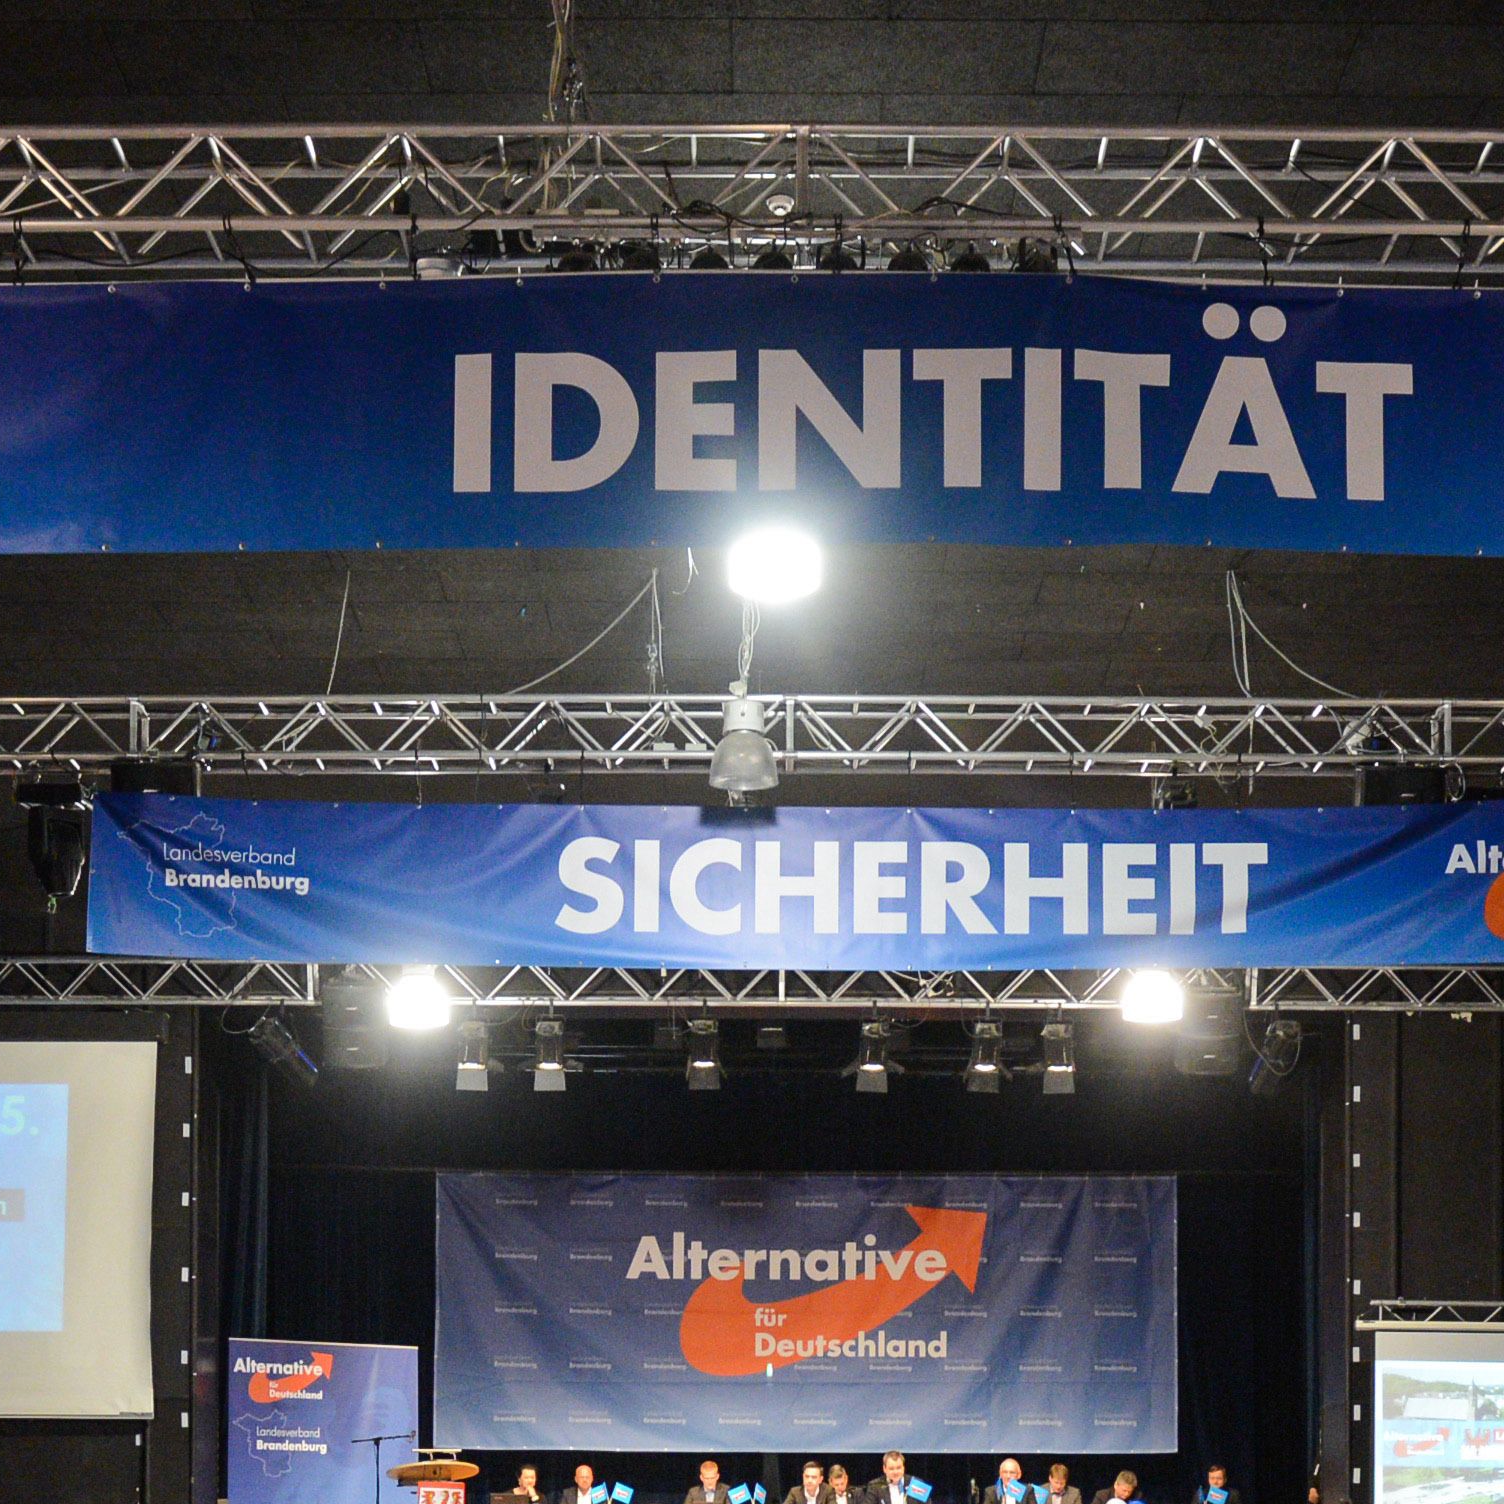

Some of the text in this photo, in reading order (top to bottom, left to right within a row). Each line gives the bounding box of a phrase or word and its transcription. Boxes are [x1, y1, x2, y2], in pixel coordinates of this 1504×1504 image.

[453, 302, 1414, 501] IDENTITÄT
[163, 842, 296, 867] Landesverband
[164, 869, 310, 896] Brandenburg
[554, 836, 1269, 935] SICHERHEIT
[626, 1231, 948, 1281] Alternative
[754, 1307, 788, 1327] für
[754, 1331, 948, 1358] Deutschland
[233, 1357, 323, 1377] Alternative
[269, 1389, 323, 1400] Deutschland
[256, 1426, 320, 1438] Landesverband
[256, 1440, 327, 1455] Brandenburg
